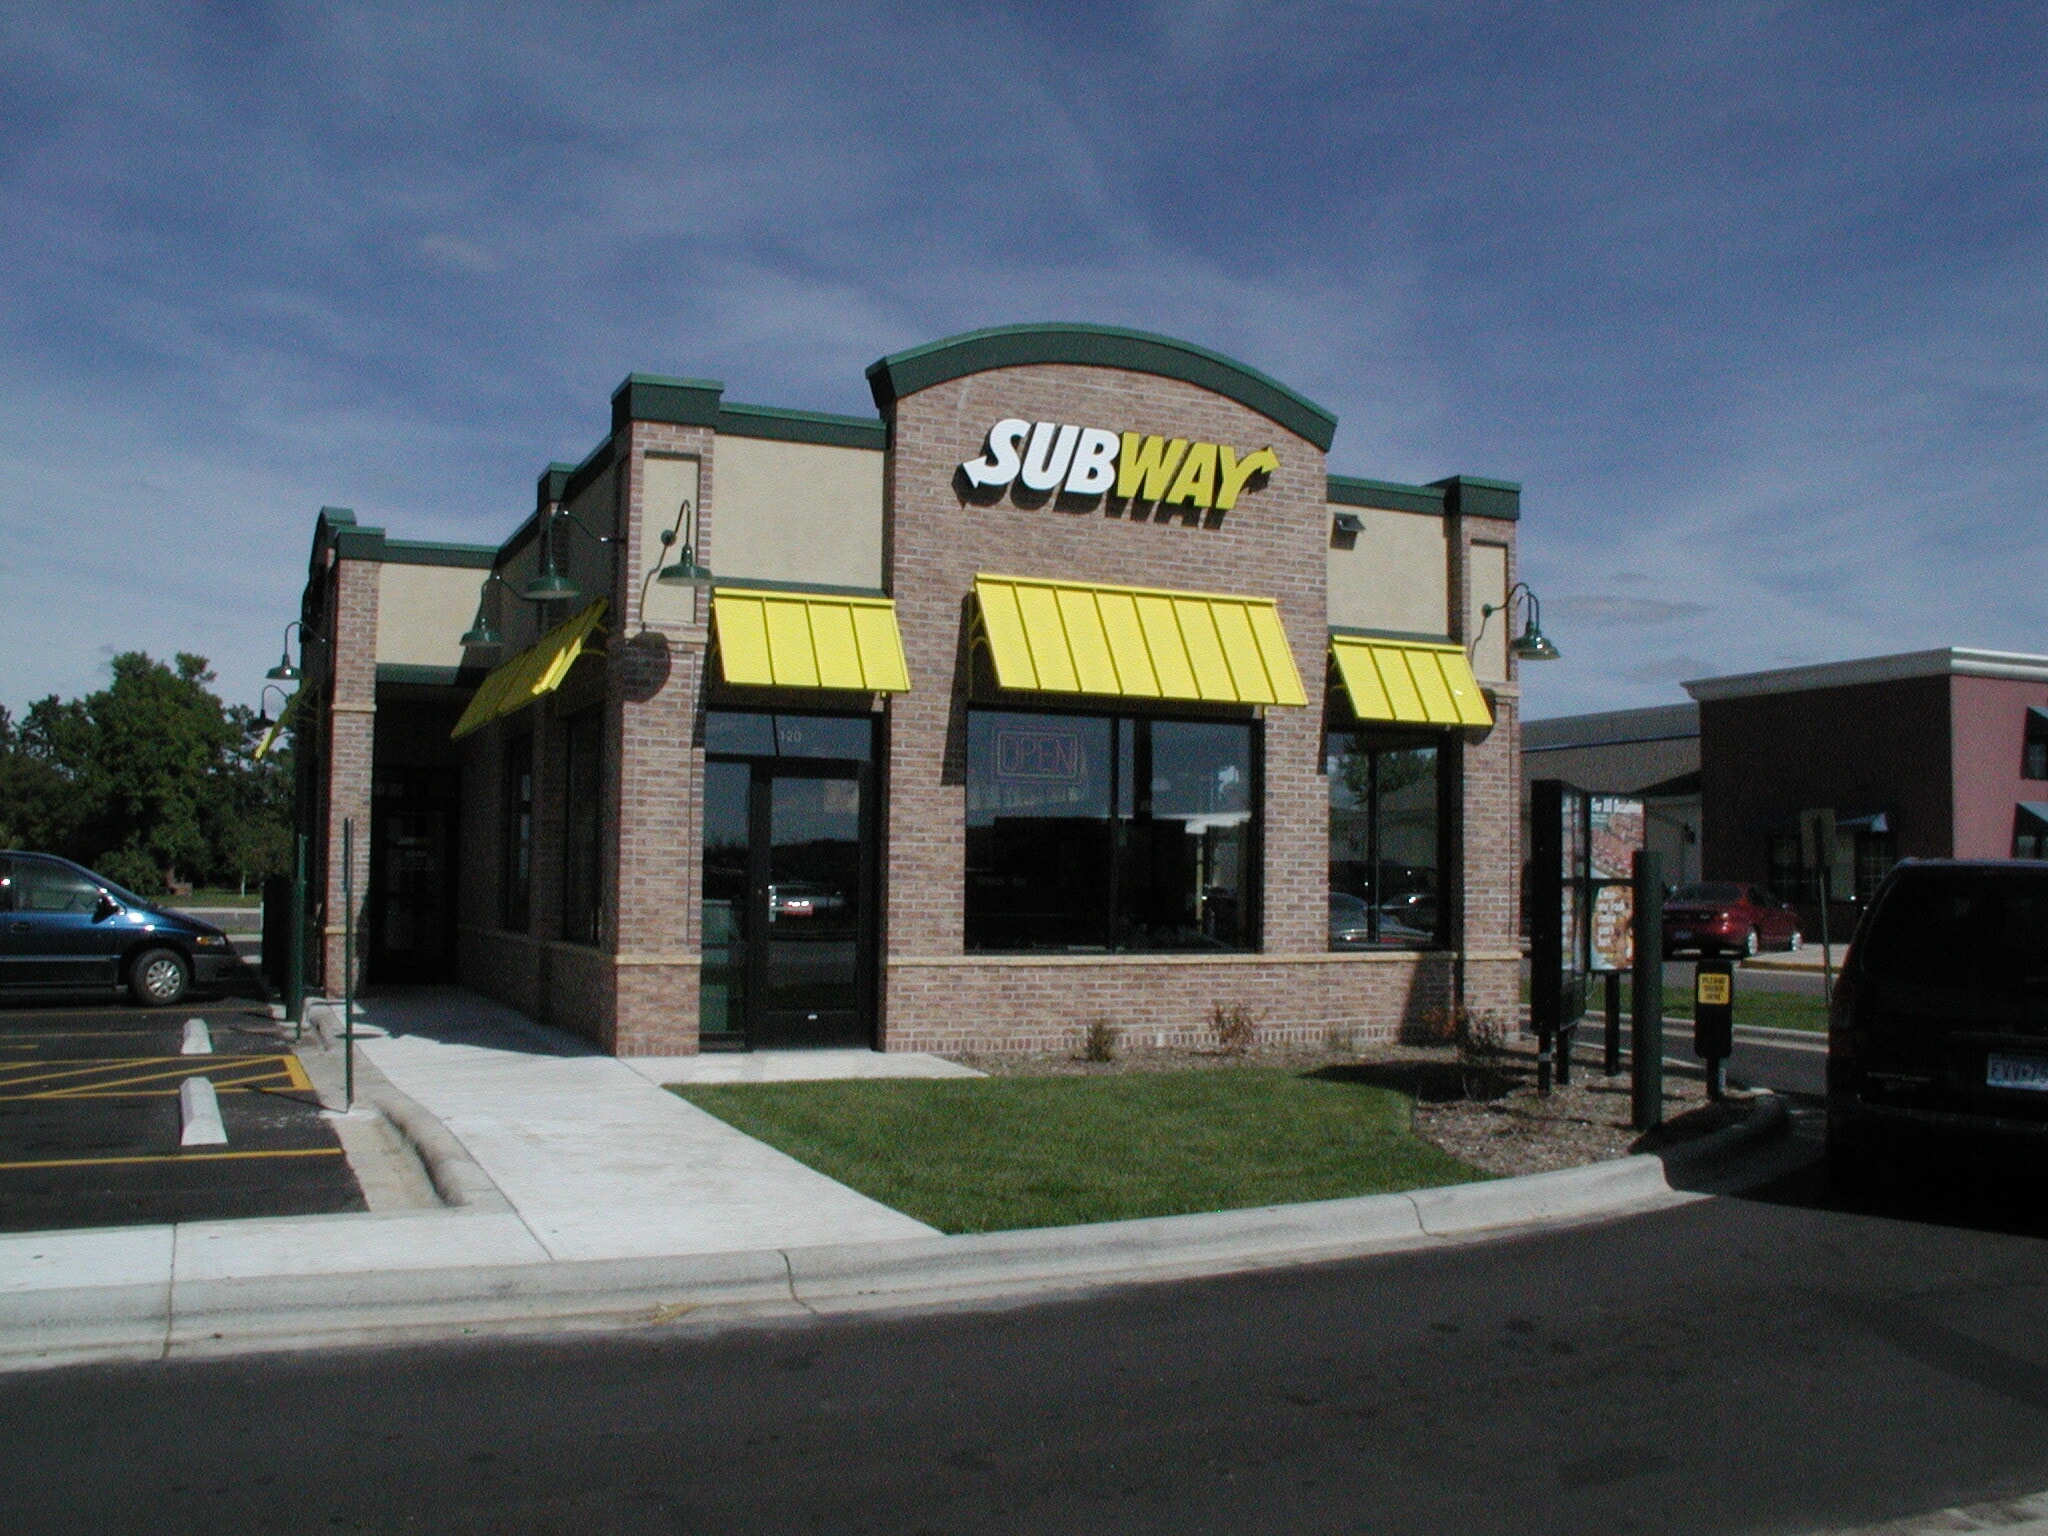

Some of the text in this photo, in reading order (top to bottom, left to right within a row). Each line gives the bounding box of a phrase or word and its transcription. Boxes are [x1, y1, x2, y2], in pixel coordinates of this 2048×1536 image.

[963, 418, 1281, 510] SUBWAY
[779, 730, 803, 743] 120
[1002, 736, 1074, 773] OPEN
